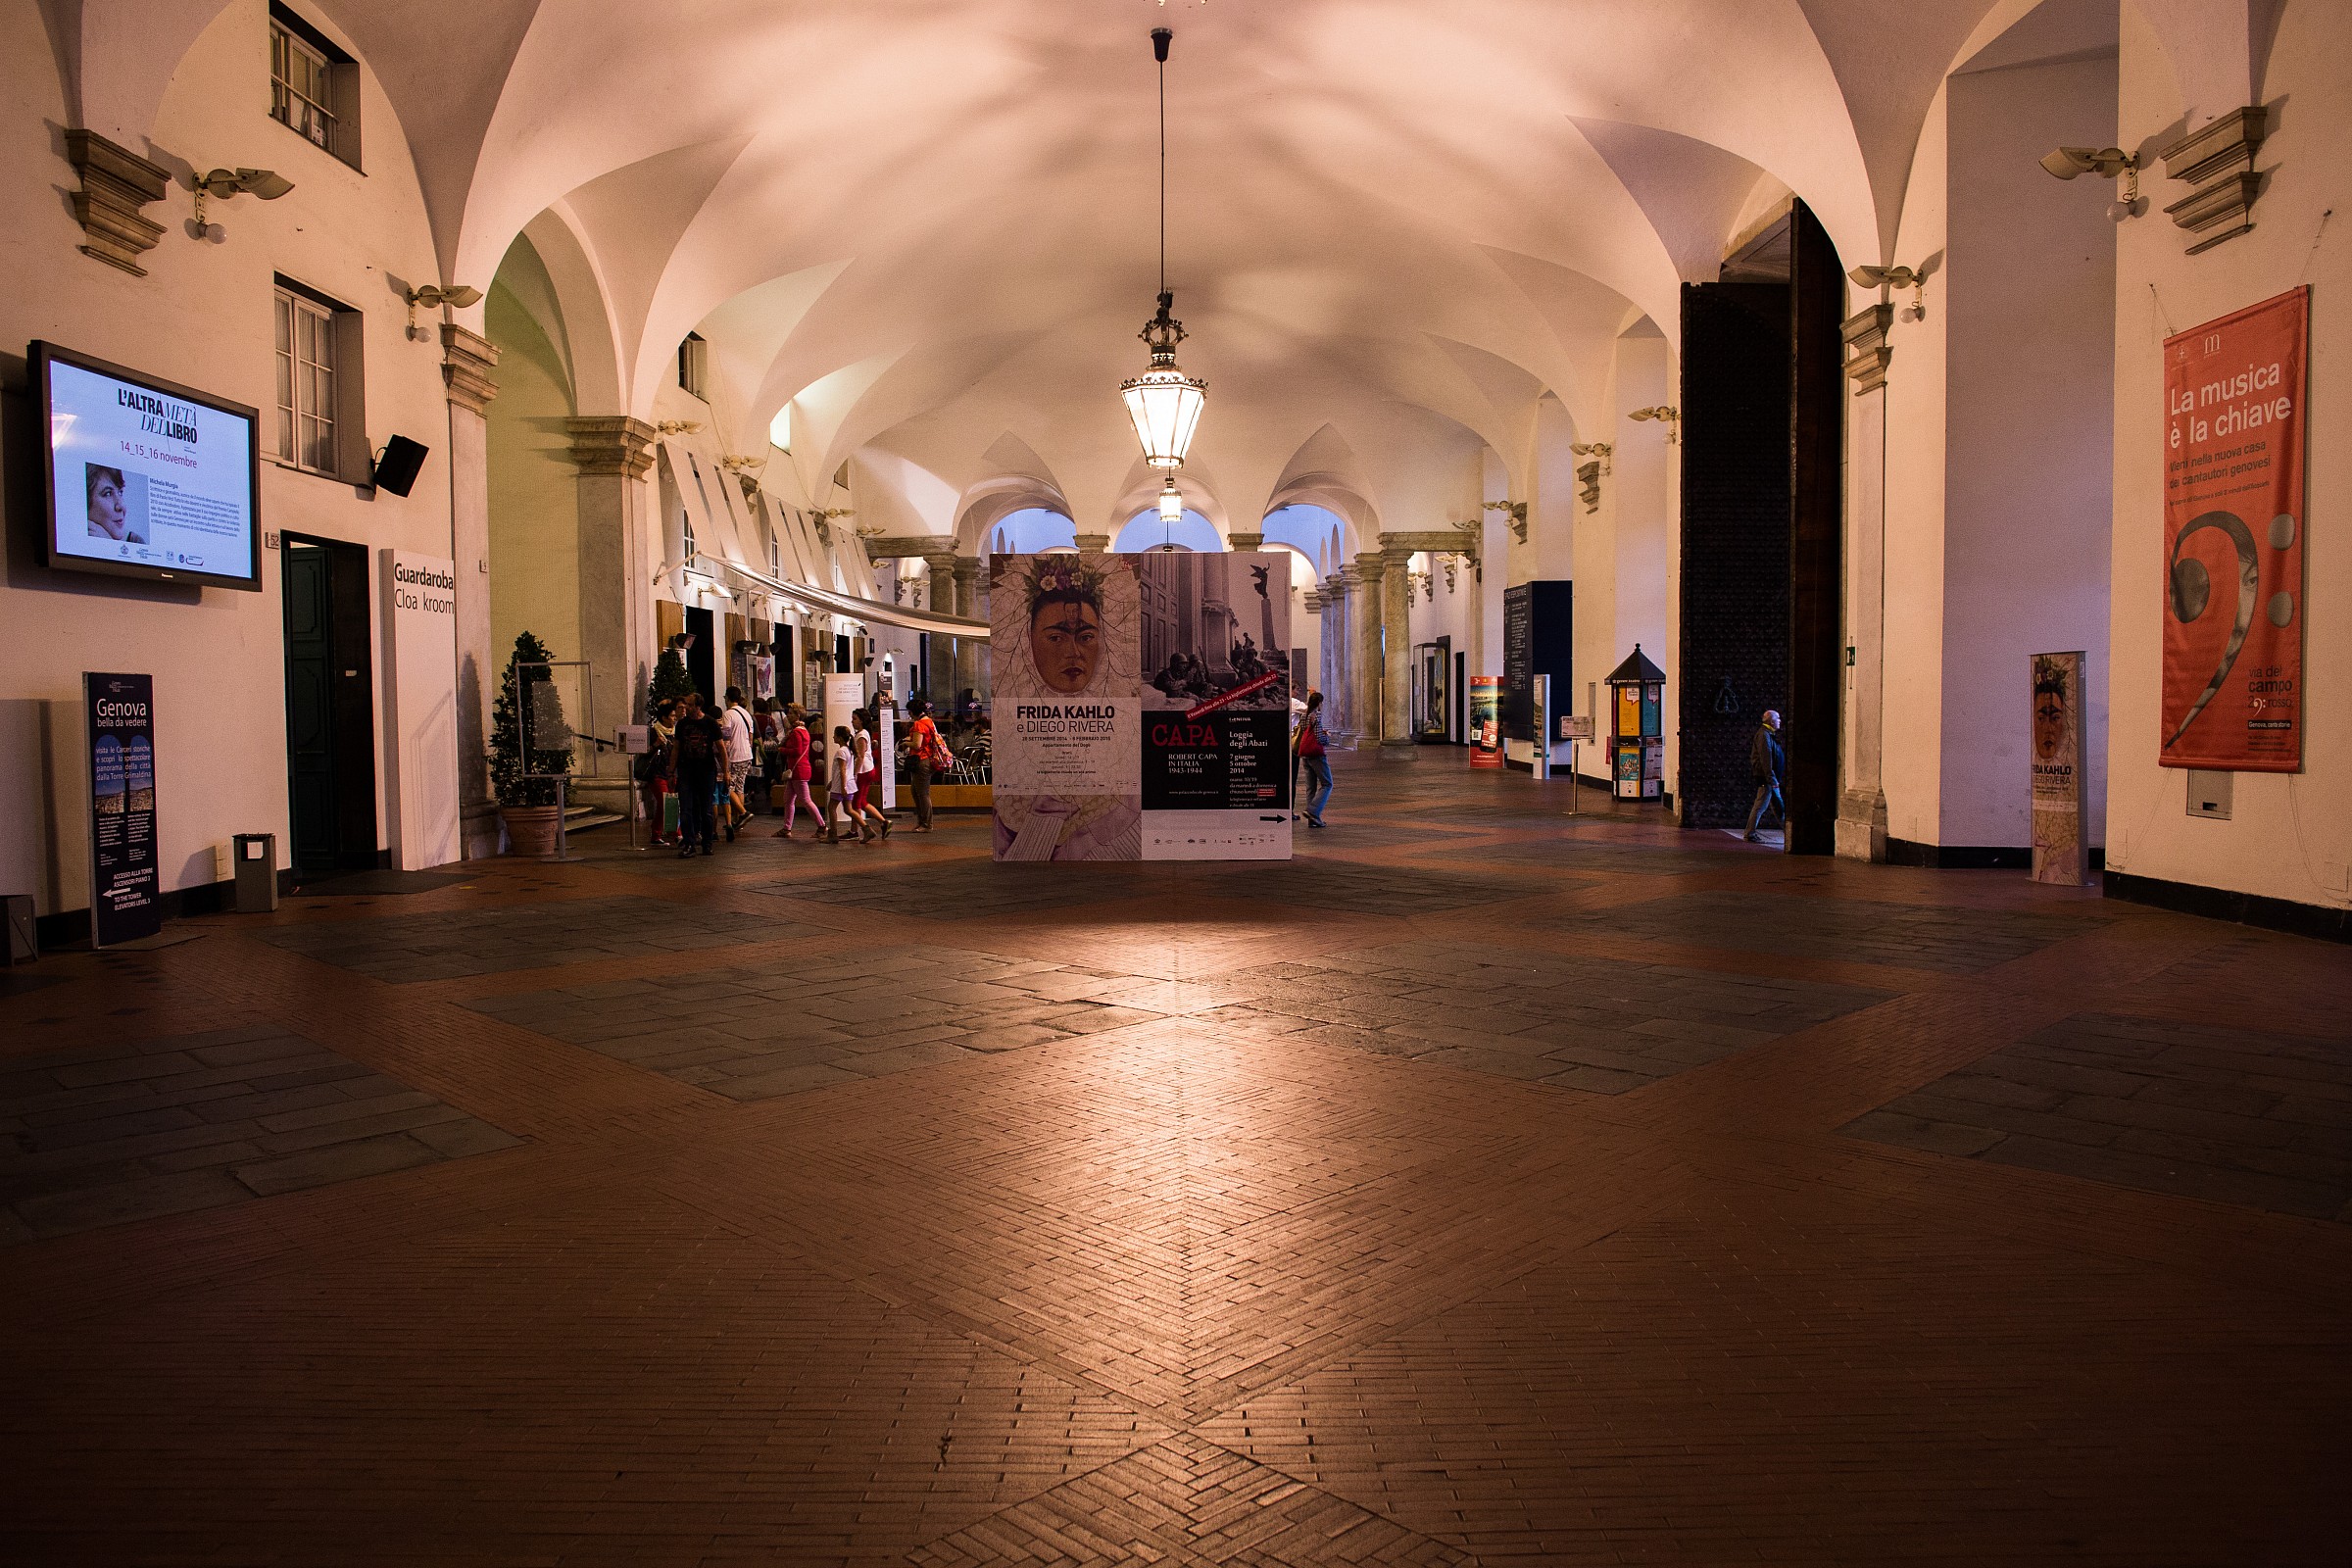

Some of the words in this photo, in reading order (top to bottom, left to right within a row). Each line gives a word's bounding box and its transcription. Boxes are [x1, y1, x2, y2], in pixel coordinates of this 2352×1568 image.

[2171, 388, 2194, 416] La
[2200, 363, 2280, 407] musica
[2170, 420, 2180, 449] è
[2189, 416, 2208, 444] la
[2215, 396, 2291, 437] chiave
[166, 420, 198, 444] LIBRO
[160, 452, 198, 468] novembre
[2190, 453, 2213, 467] nella
[2214, 447, 2242, 462] nuova
[2243, 441, 2267, 455] casa
[2181, 466, 2229, 486] cantautori
[2230, 455, 2271, 478] genovesi
[270, 534, 279, 547] 52
[394, 563, 454, 590] Guardaroba
[394, 588, 418, 610] Cloa
[422, 591, 455, 614] kroom
[2249, 668, 2263, 678] via
[2265, 665, 2282, 677] del
[2248, 679, 2293, 695] campo
[96, 698, 147, 716] Genova
[2267, 698, 2292, 708] rosso
[1016, 706, 1062, 719] FRIDA
[1064, 705, 1115, 719] KAHLO
[97, 716, 115, 727] bella
[115, 716, 124, 727] da
[124, 716, 147, 727] vedere
[1016, 723, 1024, 733] e
[1027, 720, 1066, 733] DIEGO
[1068, 720, 1115, 733] RIVERA
[1152, 724, 1219, 747] CAPA
[1229, 731, 1253, 740] Loggia
[116, 745, 132, 754] Carceri
[1229, 740, 1248, 750] degli
[101, 756, 116, 764] scopri
[96, 764, 123, 774] panorama
[124, 762, 138, 771] della
[2043, 764, 2072, 775] KAHLO
[96, 773, 110, 782] dalla
[110, 772, 124, 781] Torre
[124, 770, 152, 780] Grimaldina
[113, 871, 131, 881] ACCESSO
[130, 869, 141, 878] ALLA
